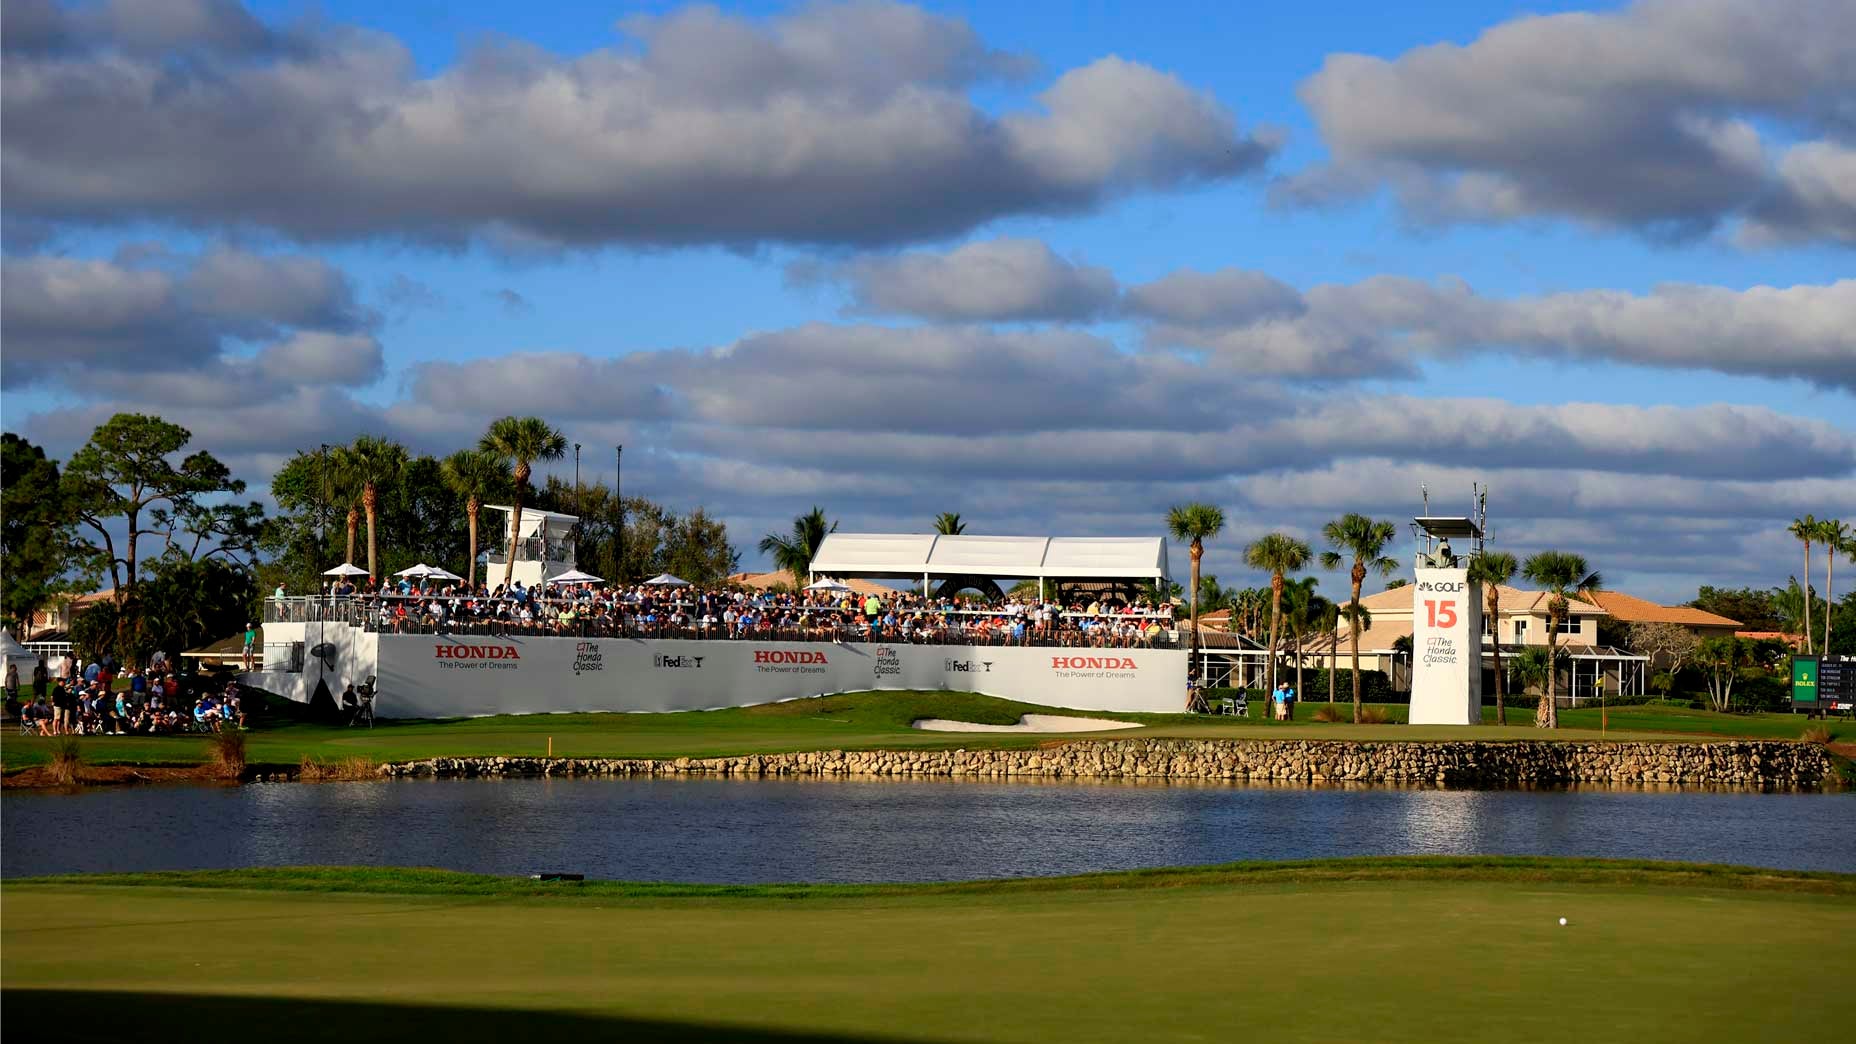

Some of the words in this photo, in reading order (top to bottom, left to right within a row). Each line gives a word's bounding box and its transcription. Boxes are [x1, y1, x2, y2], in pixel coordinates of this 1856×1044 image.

[1434, 582, 1464, 592] GOLF
[1424, 599, 1458, 629] 15
[585, 642, 599, 652] The
[1437, 637, 1453, 647] The
[435, 645, 521, 659] HONDA
[885, 647, 897, 657] The
[1427, 646, 1456, 655] Honda
[577, 652, 602, 662] Honda
[754, 650, 828, 664] HONDA
[877, 656, 899, 665] Honda
[1423, 654, 1457, 664] Classic
[439, 661, 454, 669] The
[454, 661, 478, 669] Power
[479, 661, 488, 669] of
[488, 661, 518, 669] Dreams
[573, 661, 603, 671] Classic
[1051, 657, 1138, 670] HONDA
[757, 665, 770, 673] The
[800, 666, 826, 674] Dreams
[873, 665, 901, 675] Classic
[1105, 671, 1136, 679] Dreams
